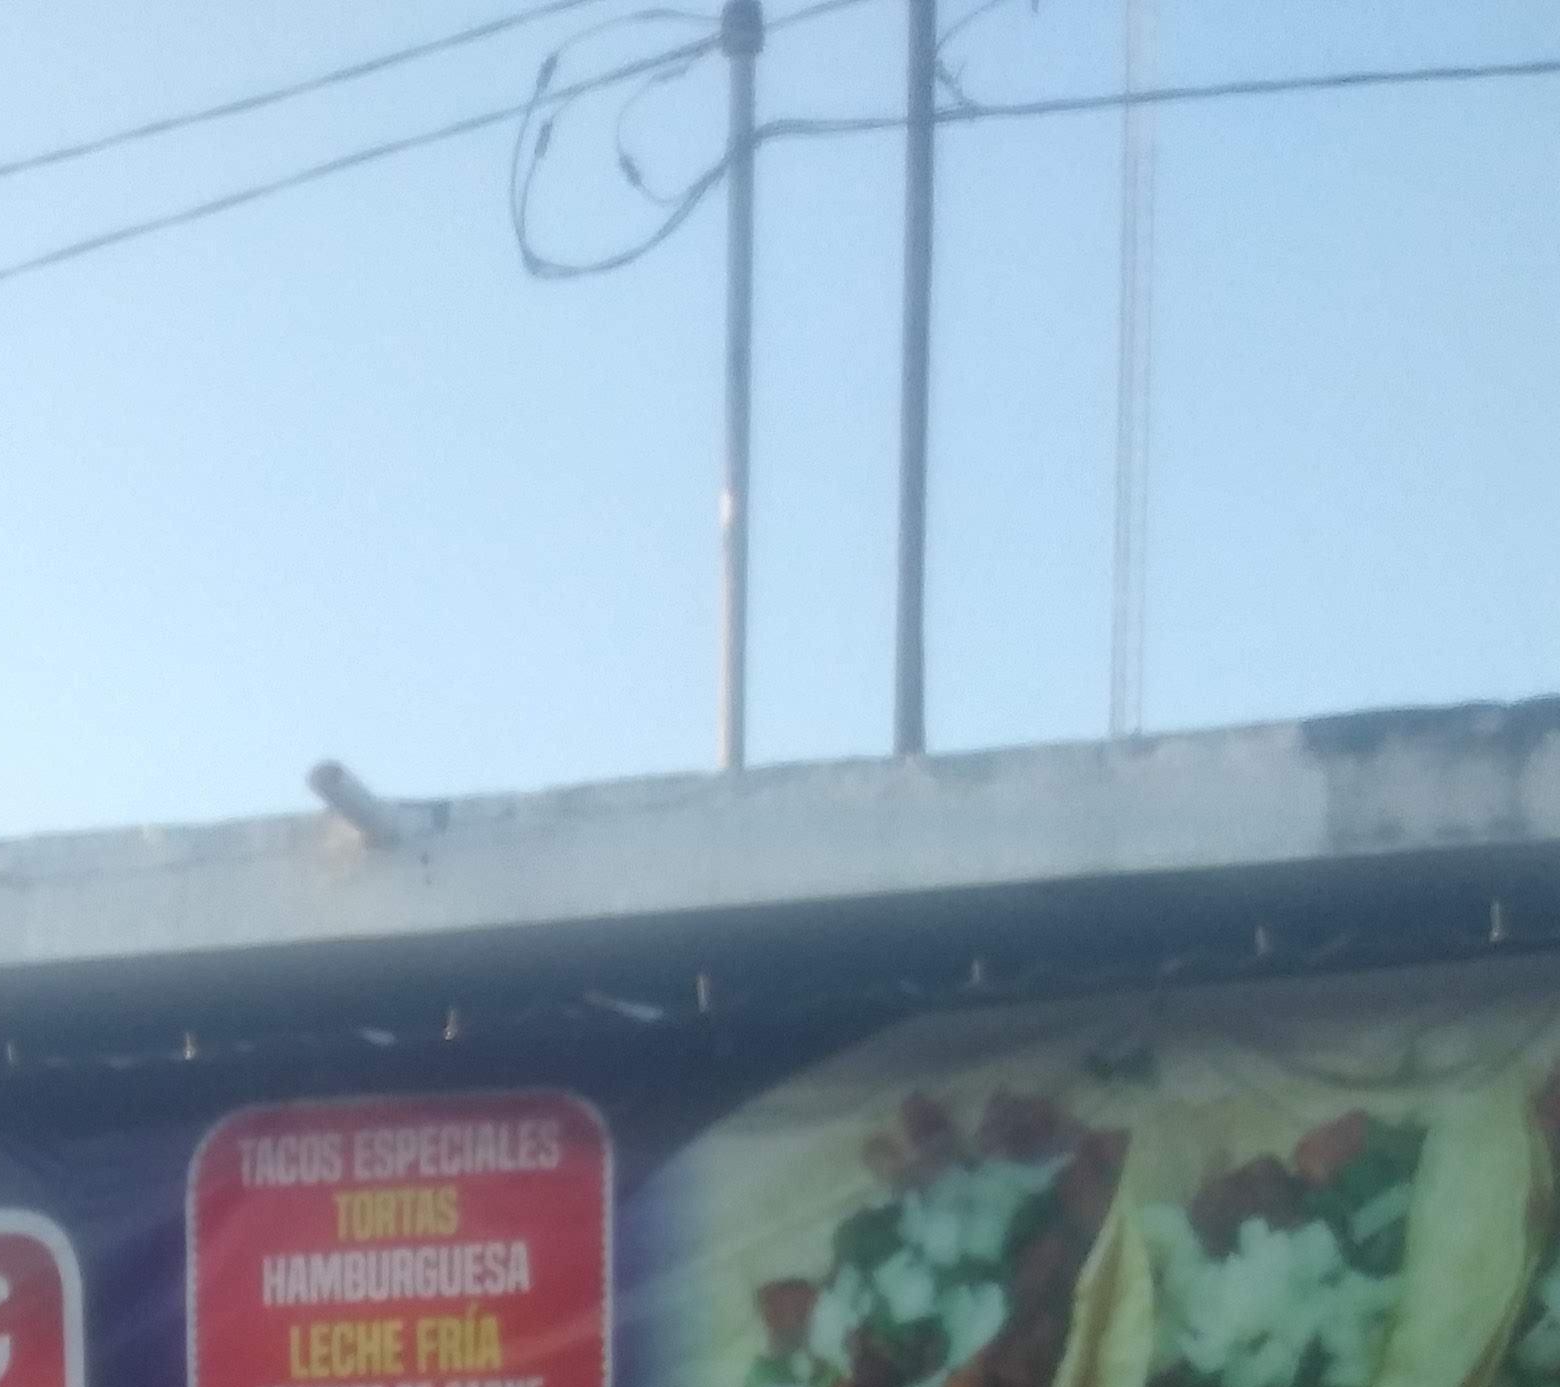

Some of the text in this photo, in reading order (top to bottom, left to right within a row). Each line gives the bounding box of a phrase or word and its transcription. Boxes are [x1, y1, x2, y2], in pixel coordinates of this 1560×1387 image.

[240, 1119, 561, 1187] TACOS ESPECIALES
[335, 1184, 459, 1240] TORTAS
[263, 1241, 530, 1307] HAMBURGUESA
[289, 1319, 404, 1379] LECHE
